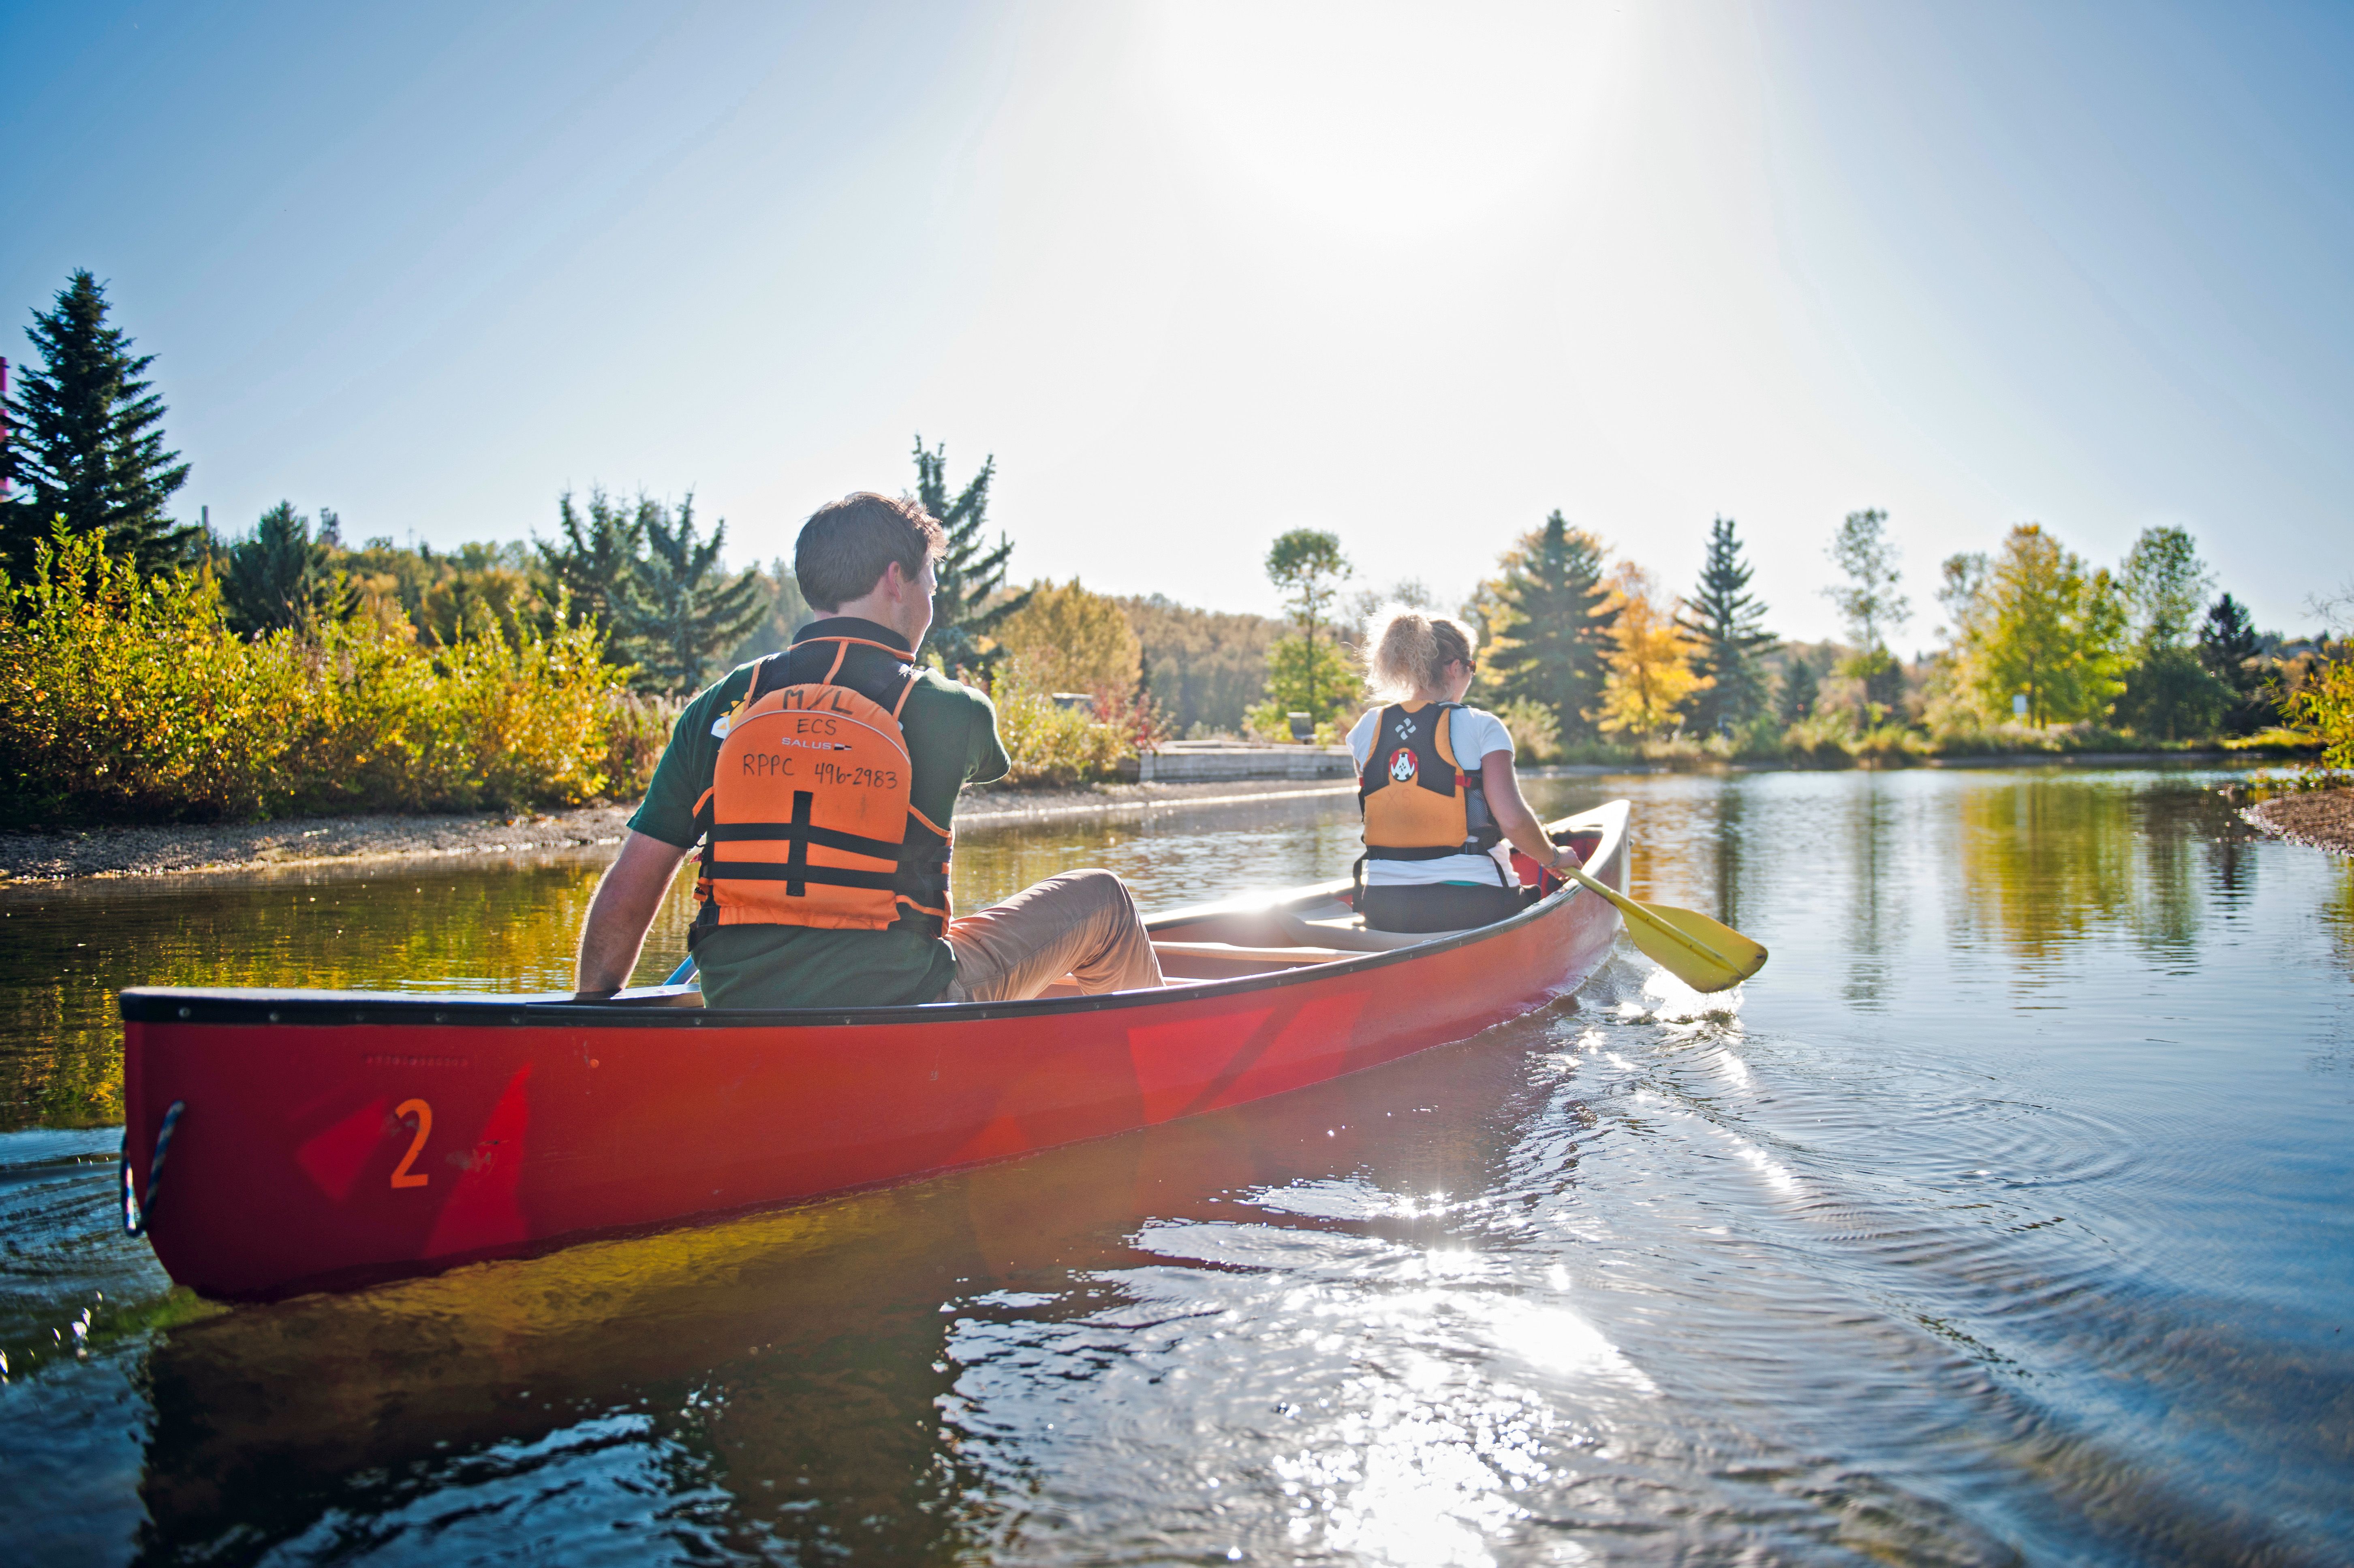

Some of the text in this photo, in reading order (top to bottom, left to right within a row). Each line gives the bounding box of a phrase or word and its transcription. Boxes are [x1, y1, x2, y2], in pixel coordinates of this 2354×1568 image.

[783, 688, 853, 715] M/L
[797, 718, 836, 735] ECS
[782, 737, 832, 750] SALUS
[743, 754, 898, 789] RPPC 496-2983
[391, 1098, 432, 1188] 2
